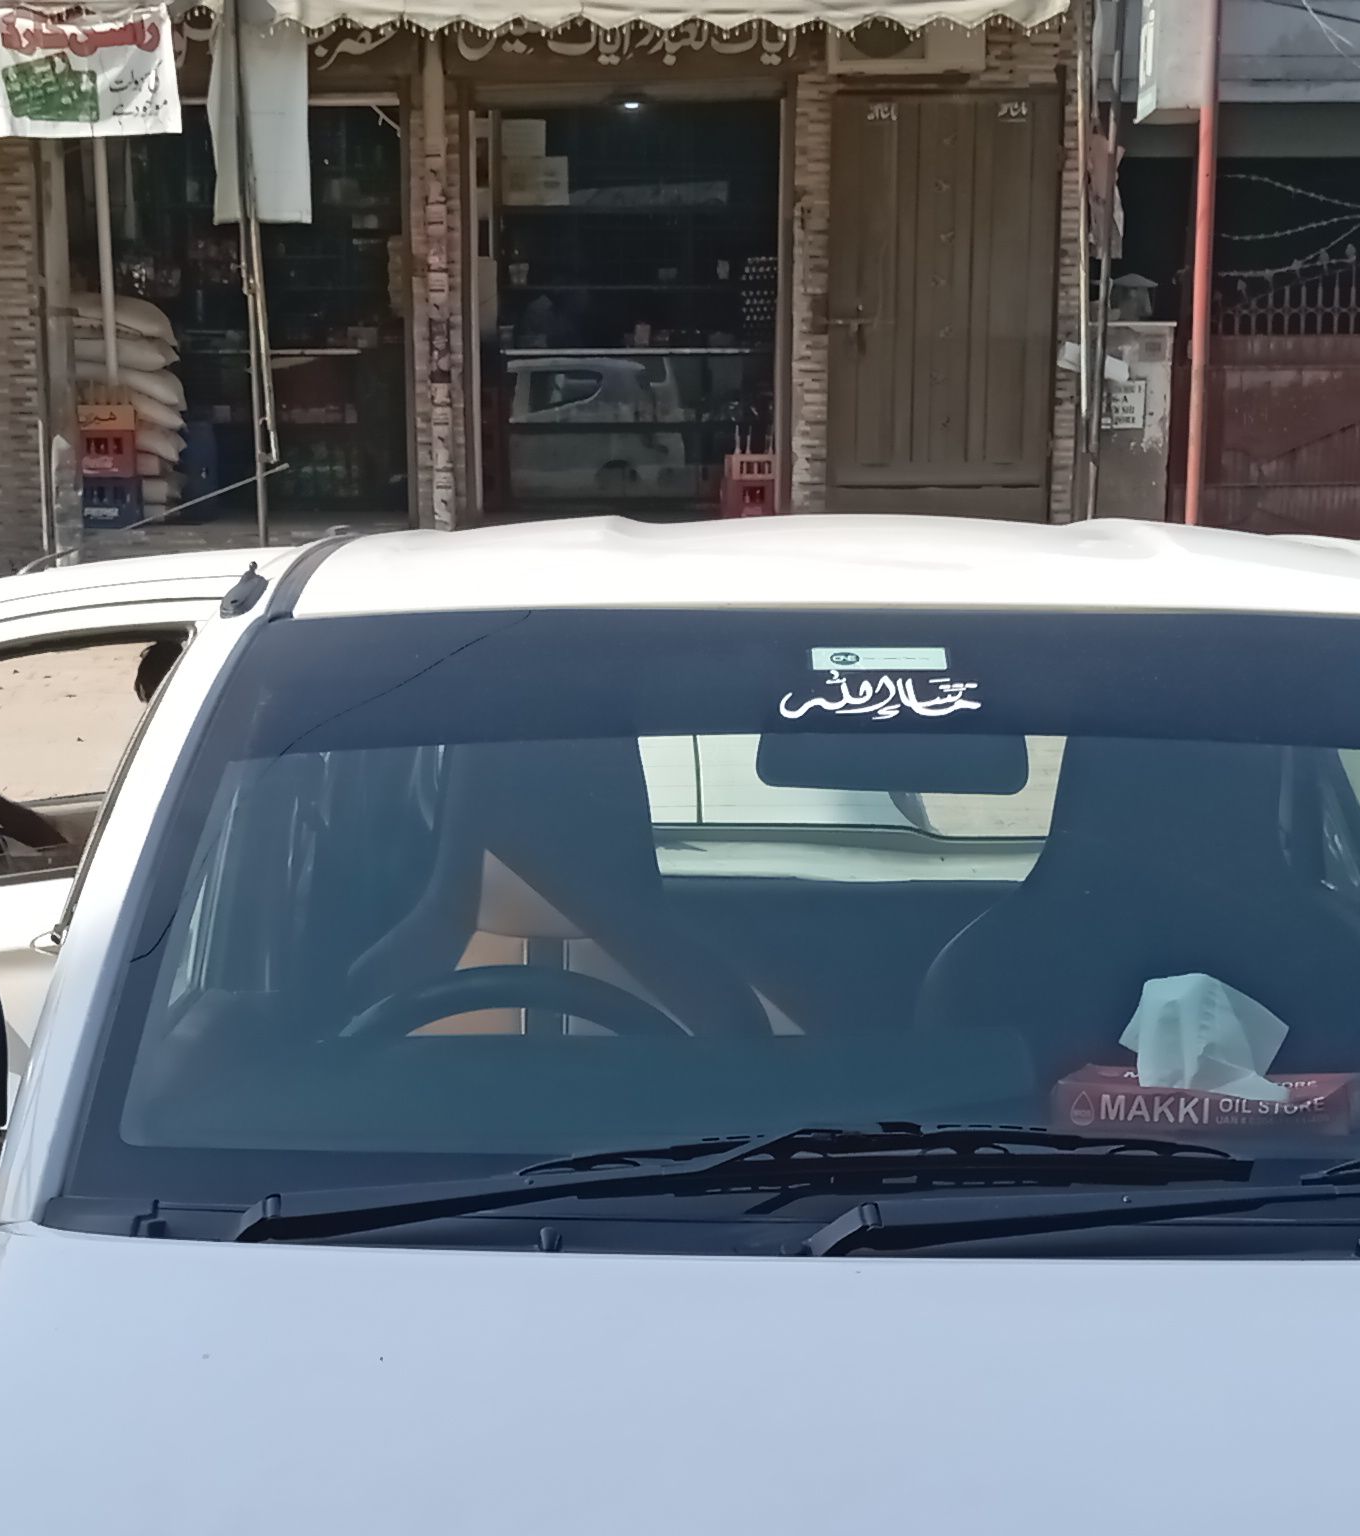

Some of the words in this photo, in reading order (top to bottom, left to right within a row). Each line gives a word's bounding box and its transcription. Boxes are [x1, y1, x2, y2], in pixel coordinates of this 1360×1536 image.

[1100, 1094, 1210, 1125] MAKKI
[1219, 1098, 1252, 1115] OIL
[1258, 1097, 1326, 1115] STORE
